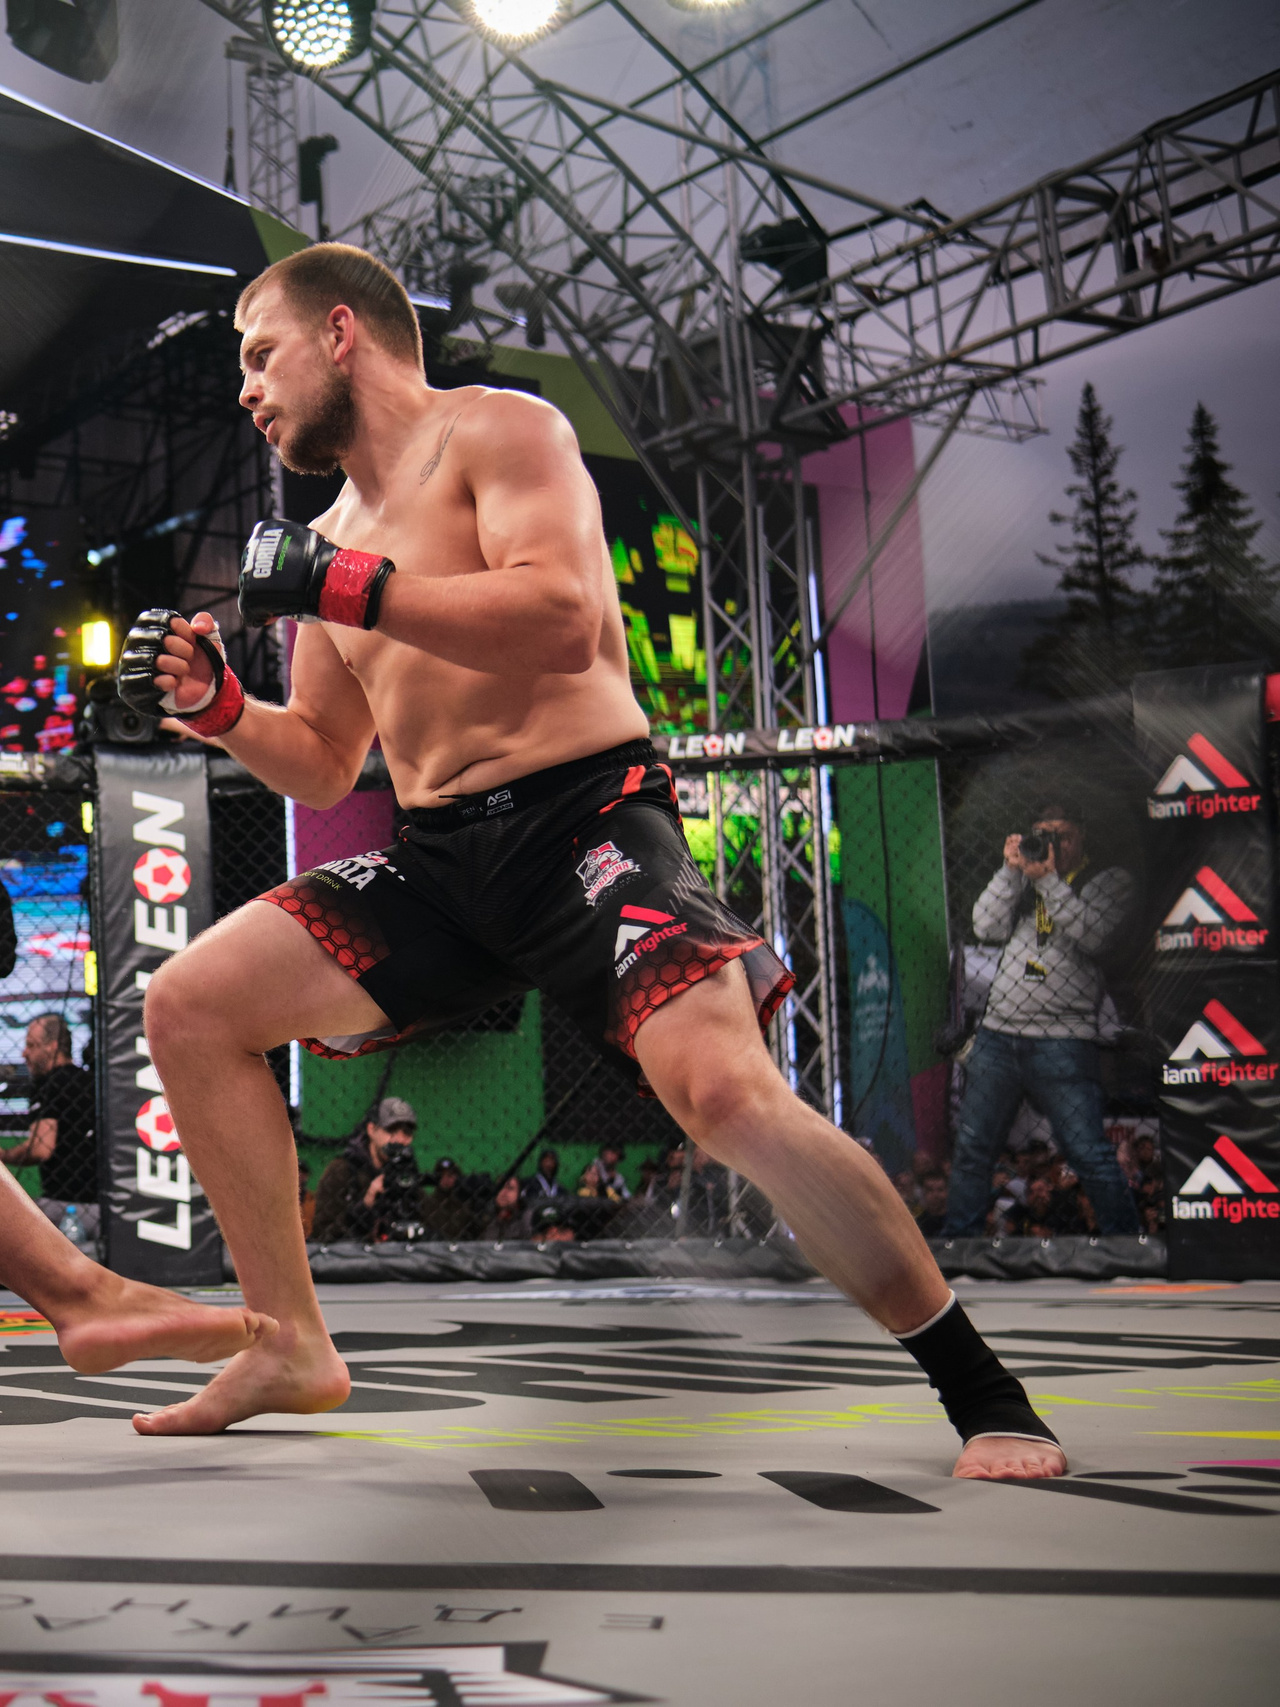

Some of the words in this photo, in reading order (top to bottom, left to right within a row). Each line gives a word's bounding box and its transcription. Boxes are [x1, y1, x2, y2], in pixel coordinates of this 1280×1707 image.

[253, 528, 284, 579] GORILLA
[668, 732, 746, 759] LEON
[777, 724, 856, 752] LEON
[487, 789, 512, 807] ASI
[1147, 794, 1262, 819] iamfighter
[313, 860, 378, 892] ILLA
[589, 861, 630, 898] ДОБРЫНЯ
[132, 791, 189, 992] EON
[615, 922, 688, 978] iamfighter
[1155, 927, 1270, 952] iamfighter
[1163, 1062, 1280, 1087] iamfighter
[1172, 1195, 1280, 1223] iamfighte
